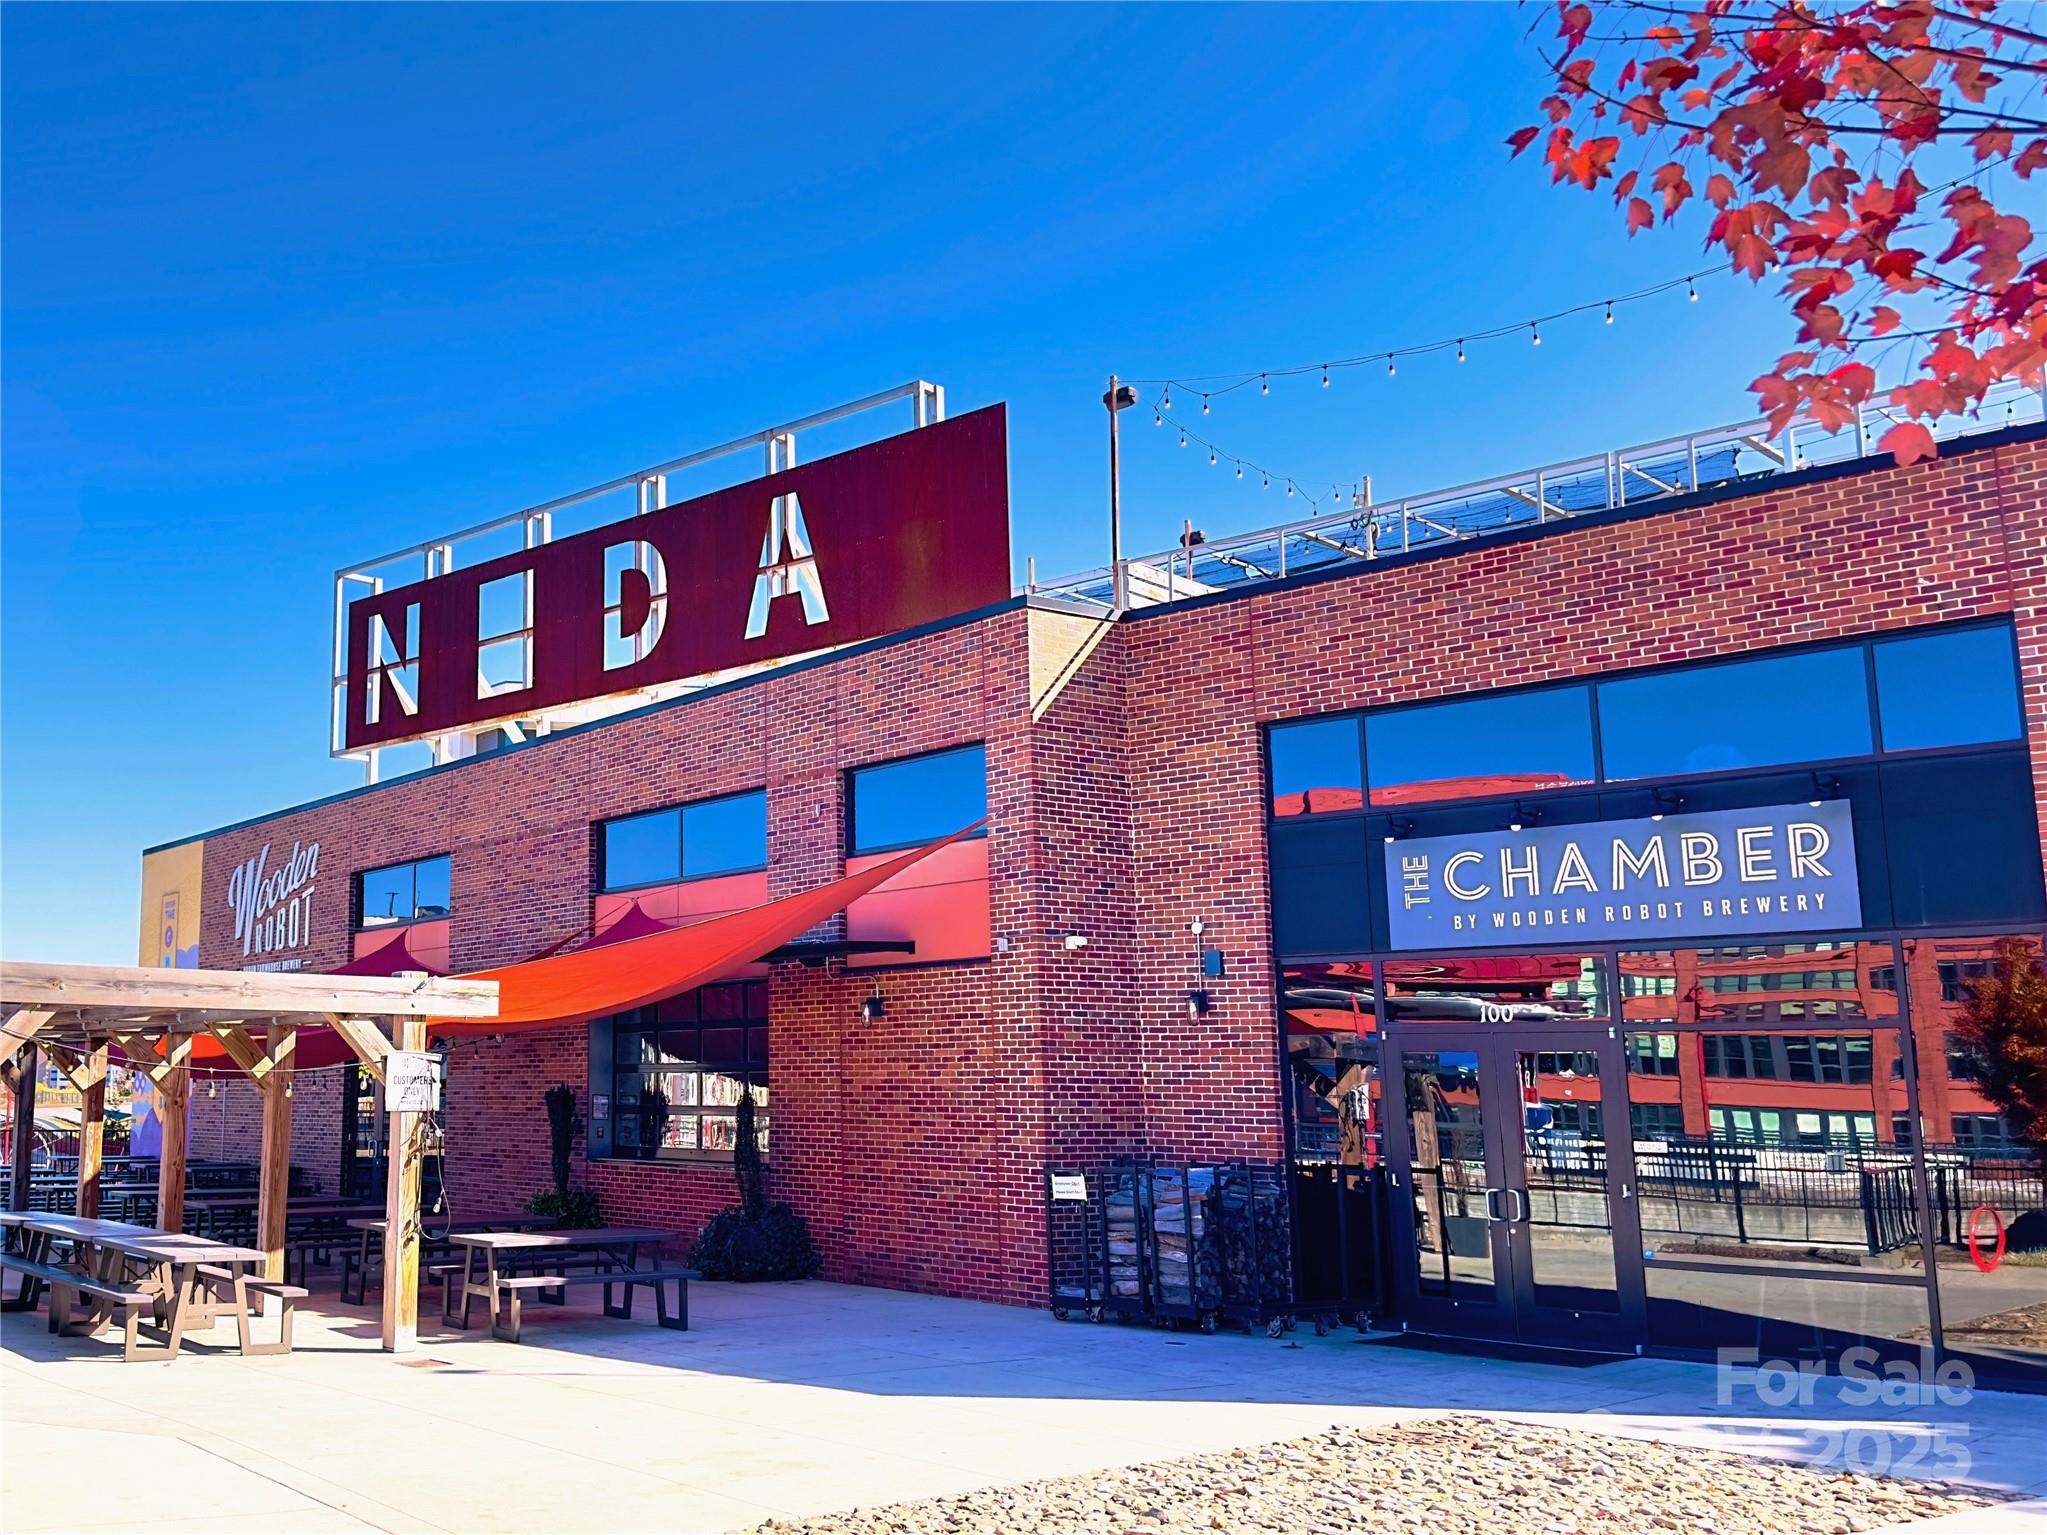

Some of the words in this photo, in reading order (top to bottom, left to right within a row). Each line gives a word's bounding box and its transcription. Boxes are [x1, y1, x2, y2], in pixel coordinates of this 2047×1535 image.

[228, 841, 319, 957] Wooden
[1403, 855, 1431, 910] THE
[1443, 823, 1832, 900] CHAMBER
[255, 886, 315, 953] ROBOT
[1453, 914, 1477, 930] BY
[1492, 907, 1587, 928] WOODEN
[1605, 902, 1684, 923] ROBOT
[1703, 893, 1827, 917] BREWERY
[1480, 1005, 1514, 1023] 100
